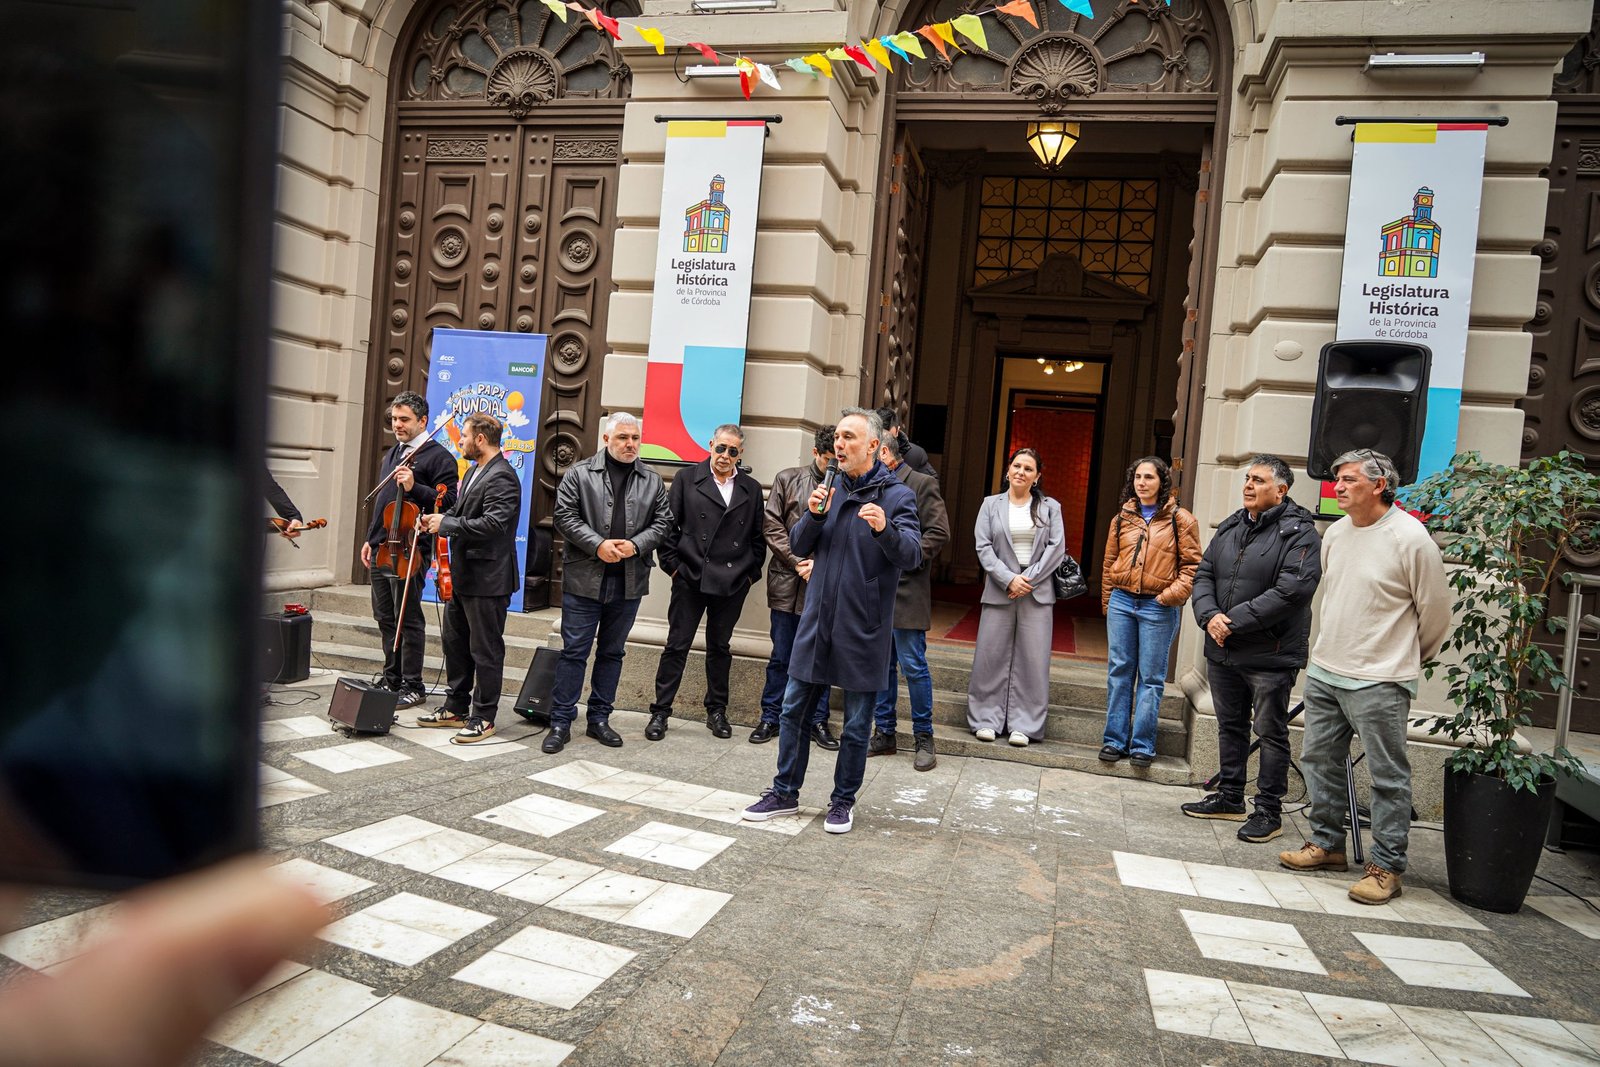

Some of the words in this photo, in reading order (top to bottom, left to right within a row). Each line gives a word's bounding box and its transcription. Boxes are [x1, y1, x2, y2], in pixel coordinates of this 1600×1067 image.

[671, 258, 736, 273] Legislatura
[676, 274, 728, 286] Histórica
[687, 288, 693, 296] la
[694, 288, 727, 297] Provincia
[1362, 283, 1450, 300] Legislatura
[692, 297, 720, 306] Córdoba
[1369, 301, 1439, 316] Histórica
[1369, 317, 1381, 326] de
[1383, 317, 1392, 327] la
[1394, 318, 1437, 328] Provincia
[1375, 328, 1387, 337] de
[1389, 328, 1428, 339] Córdoba
[451, 396, 508, 418] MUNDIAL
